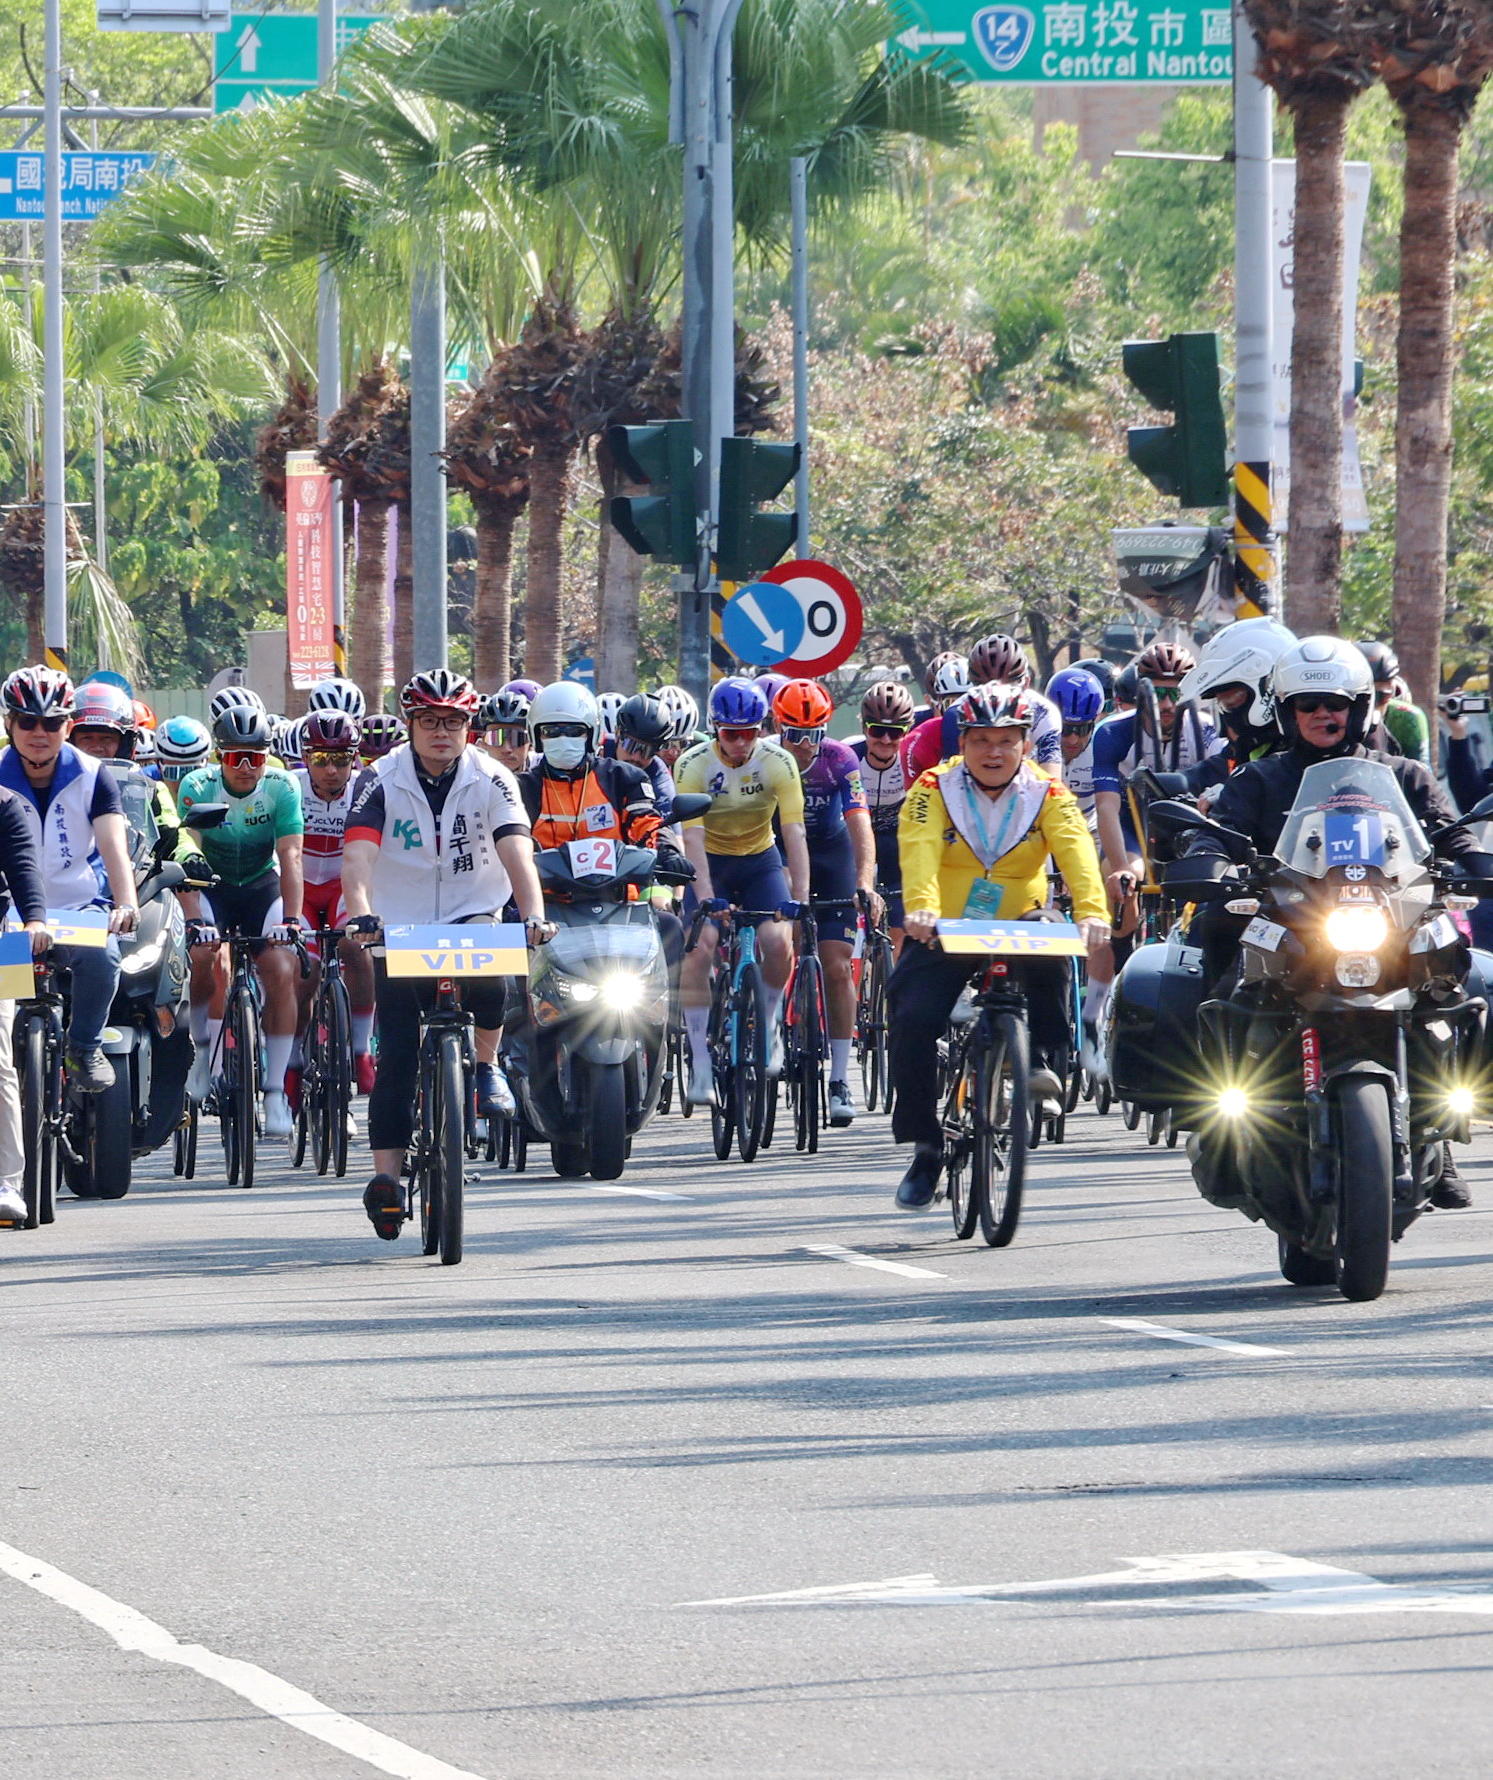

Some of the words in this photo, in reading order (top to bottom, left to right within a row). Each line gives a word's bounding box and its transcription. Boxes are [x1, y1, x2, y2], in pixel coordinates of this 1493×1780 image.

[987, 15, 1020, 41] 14
[1042, 1, 1232, 47] 南投市區
[1041, 50, 1136, 77] Central
[16, 156, 157, 191] 國局南投
[1304, 672, 1331, 681] SHOEI
[449, 813, 475, 875] 簡千翔
[1331, 840, 1355, 852] TV
[1352, 818, 1370, 860] 1
[593, 841, 613, 871] 2
[978, 938, 1051, 950] VIP
[420, 953, 495, 970] VIP
